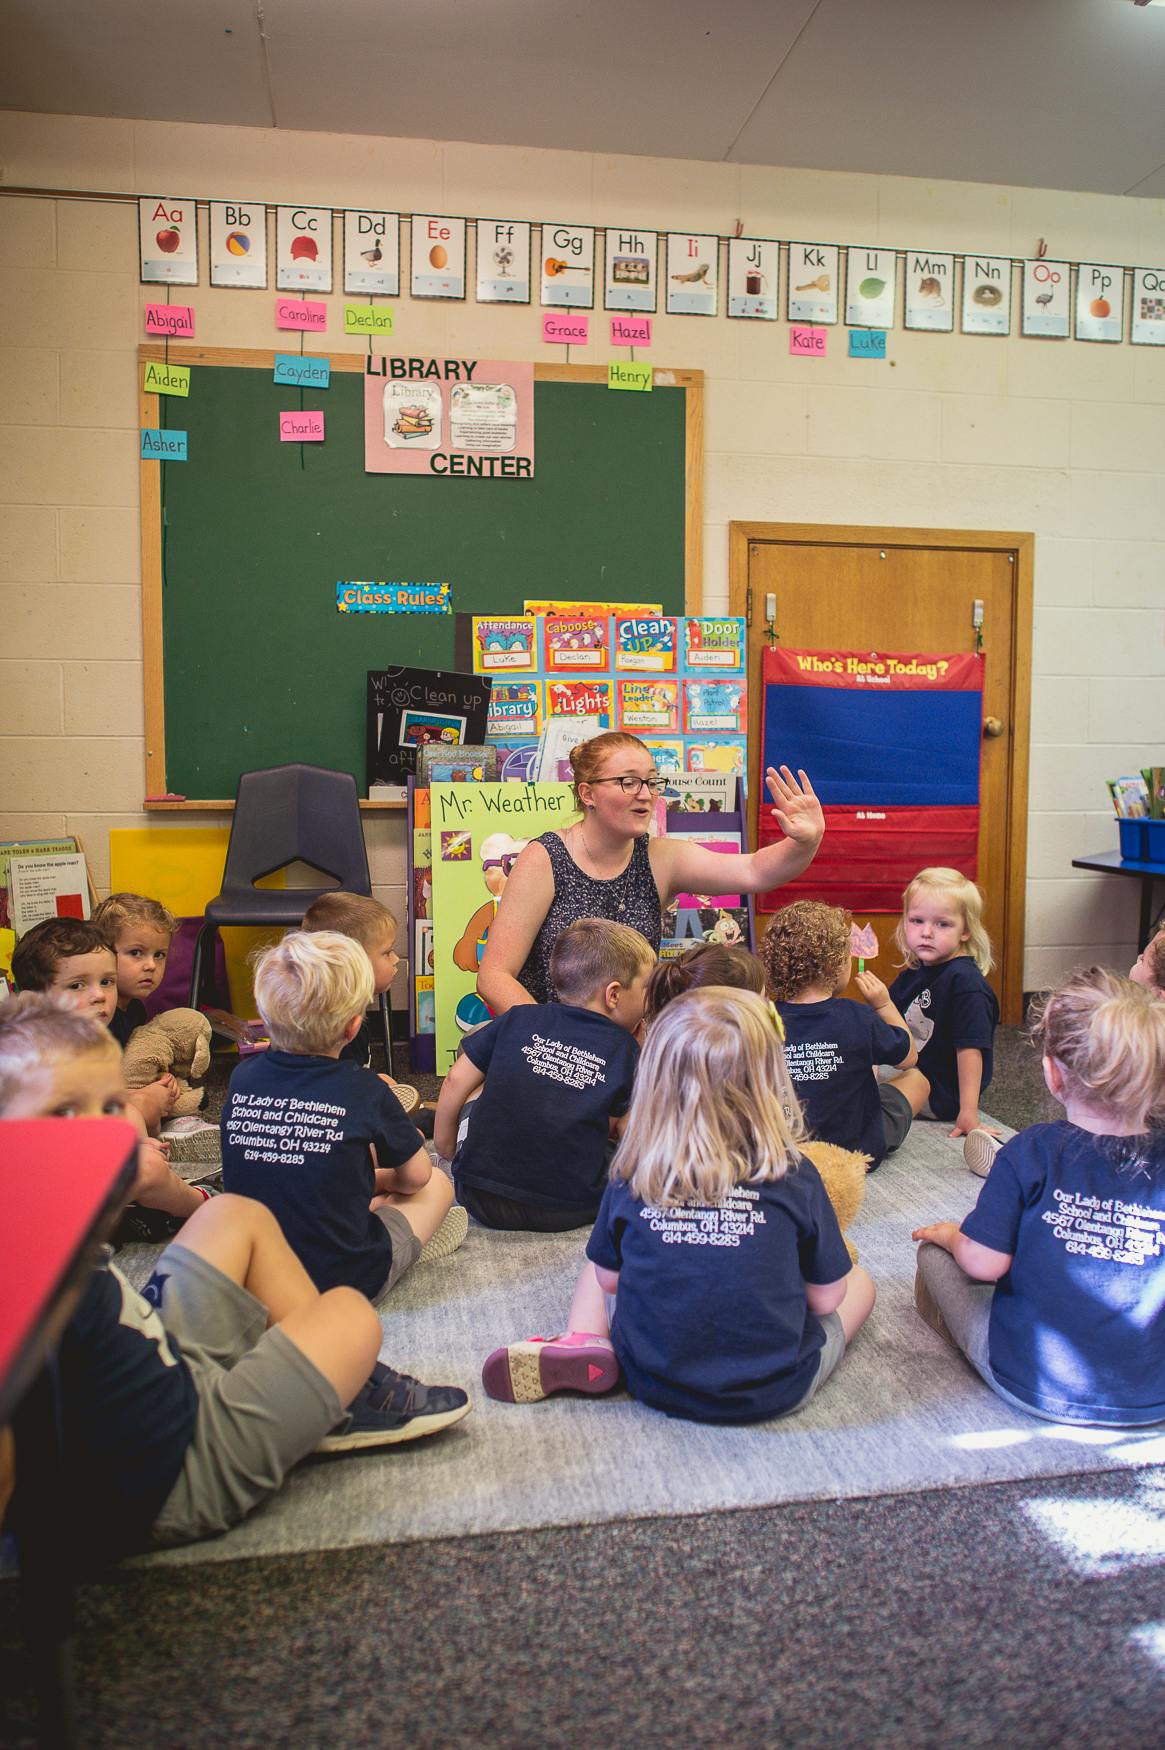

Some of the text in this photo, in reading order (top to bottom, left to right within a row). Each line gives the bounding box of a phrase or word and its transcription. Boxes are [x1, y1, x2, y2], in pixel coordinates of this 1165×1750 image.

[152, 203, 183, 223] Aa
[225, 206, 251, 227] Bb
[291, 210, 318, 232] Cc
[358, 215, 386, 236] Dd
[428, 220, 451, 240] Ee
[495, 225, 515, 244] Ff
[553, 229, 583, 256] Gg
[619, 234, 645, 254] Hh
[688, 239, 699, 258] Ii
[747, 244, 762, 268] Jj
[803, 247, 827, 267] Kk
[866, 252, 877, 271] Ll
[913, 256, 947, 275] Mm
[975, 261, 1001, 280] Nn
[1033, 264, 1061, 284] Oo
[1091, 269, 1112, 290] Pp
[146, 307, 193, 335] Abigail
[279, 305, 326, 326] Caroline
[345, 310, 392, 329] Declan
[544, 321, 587, 339] Grace
[612, 322, 651, 341] Hazel
[792, 332, 824, 350] Kate
[850, 332, 886, 352] Luke
[146, 365, 188, 389] Aiden
[276, 362, 328, 385] Cayden
[366, 355, 478, 381] LIBRARY
[610, 365, 650, 391] Henry
[281, 420, 322, 437] Charlie
[142, 431, 186, 454] Asher
[430, 453, 532, 477] CENTER
[343, 590, 446, 606] Class Rules
[477, 621, 535, 631] Attendance
[546, 620, 597, 635] Caboose
[619, 619, 671, 638] Clean
[703, 623, 740, 635] Door
[703, 637, 742, 648] Holder
[796, 655, 950, 681] Who's Here Today?
[410, 685, 482, 711] Clean up
[623, 683, 650, 694] Line
[623, 693, 655, 703] Leader
[488, 702, 533, 718] ibrary
[562, 692, 610, 715] Lights
[695, 776, 728, 787] Count
[440, 790, 473, 822] Mr.
[479, 786, 566, 813] Weather
[531, 1033, 546, 1044] Our
[521, 1045, 542, 1058] 4567
[532, 1065, 586, 1090] 614-459-8285
[560, 1066, 574, 1078] OH
[573, 1071, 597, 1087] 43214
[231, 1092, 347, 1117] Our Lady of Bethlehem
[231, 1106, 340, 1129] School and Childcare
[226, 1119, 344, 1141] 4567 Olentangy River Rd
[228, 1133, 332, 1154] Columbus, OH 43214
[243, 1149, 305, 1165] 614-459-8285
[1052, 1188, 1075, 1204] Our
[1074, 1192, 1101, 1211] Lady
[1100, 1199, 1114, 1211] of
[719, 1209, 749, 1222] River
[1041, 1210, 1076, 1228] 4567
[1091, 1211, 1113, 1223] and
[699, 1221, 719, 1233] OH
[719, 1222, 755, 1236] 43214
[661, 1231, 742, 1247] 614-459-8285
[1105, 1235, 1125, 1250] OH
